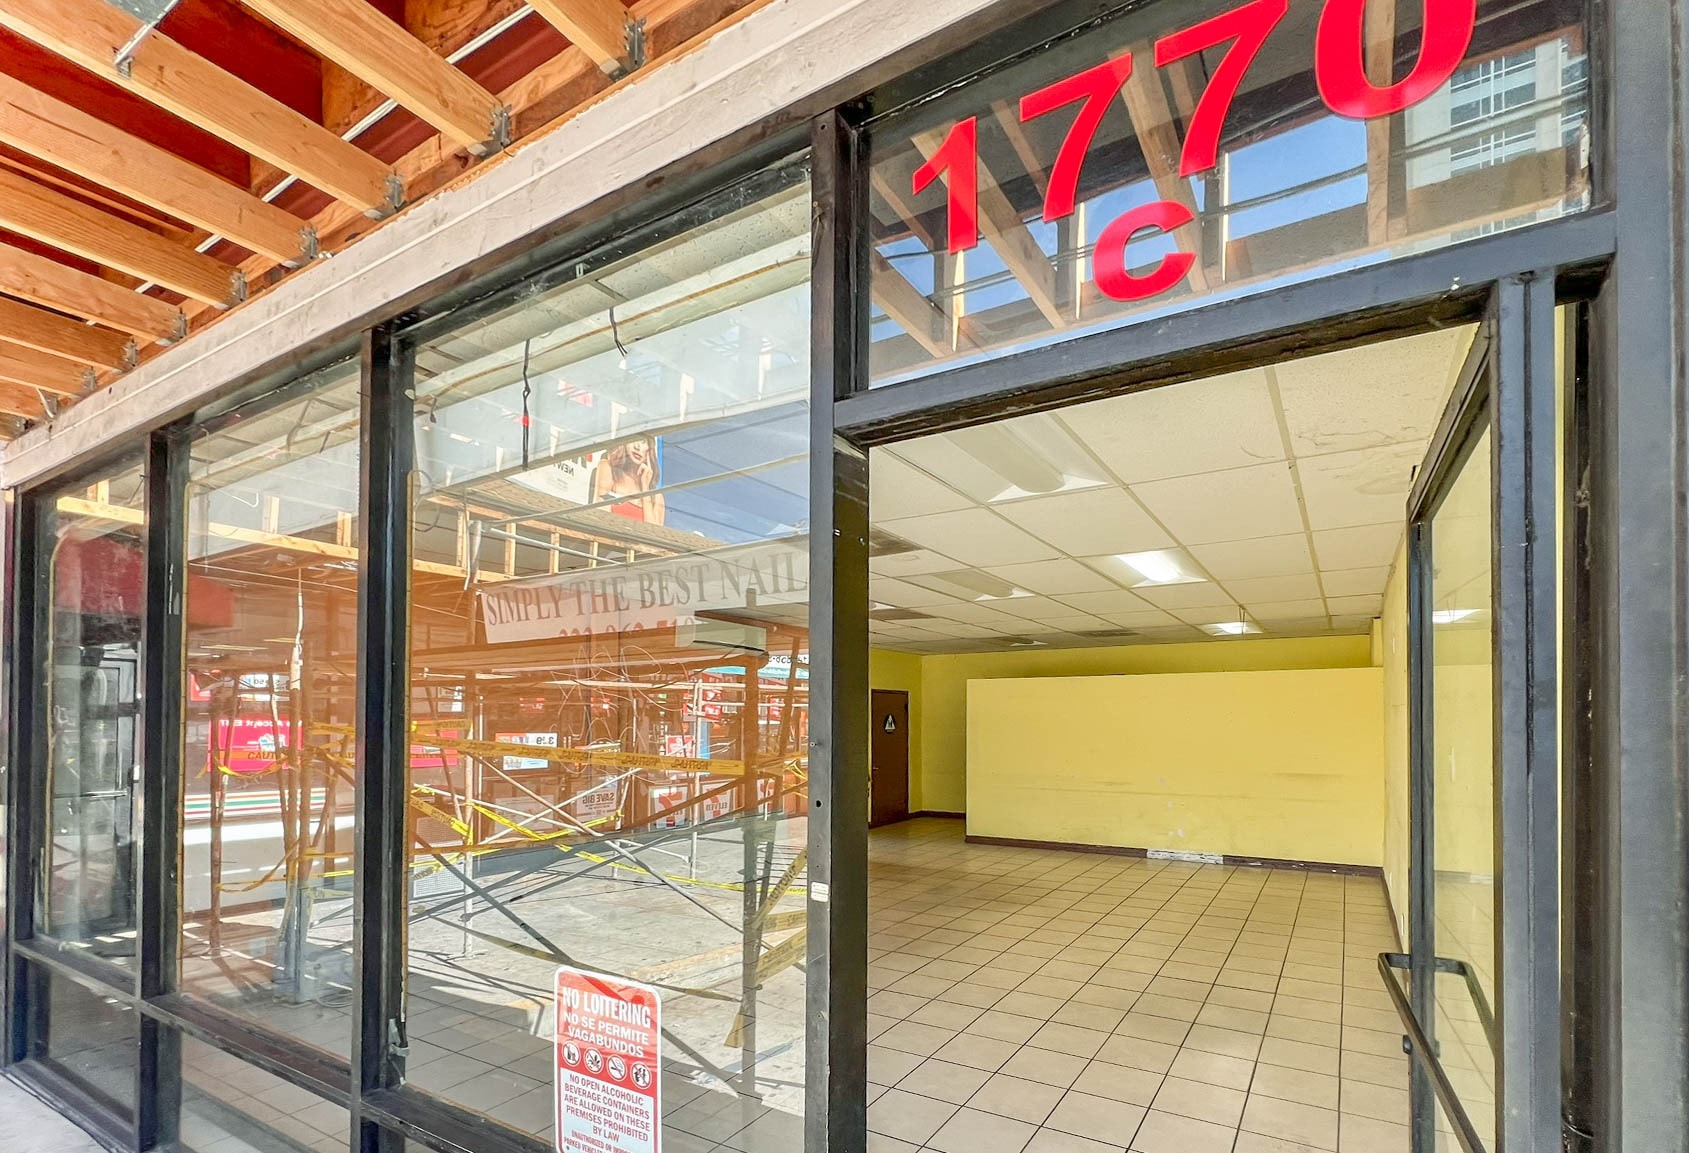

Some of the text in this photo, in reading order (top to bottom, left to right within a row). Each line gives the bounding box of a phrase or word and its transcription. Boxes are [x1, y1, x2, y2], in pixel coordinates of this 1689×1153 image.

[912, 0, 1476, 254] 1770
[487, 584, 562, 626] SIMPLY
[570, 576, 630, 616] THE
[639, 564, 709, 609] BEST
[621, 755, 661, 767] CAUTION
[670, 758, 711, 770] CAUTION
[562, 986, 651, 1029] NO LOITERING
[563, 1011, 649, 1045] NO SE PERMITE
[568, 1025, 644, 1057] VAGABUNDOS
[564, 1083, 650, 1120] BEVERAGE CONTAINERS
[569, 1073, 644, 1106] NO OPEN ALCOHOLIC
[564, 1093, 651, 1132] ARE ALLOWED ON THESE
[566, 1104, 649, 1142] PREMISES PROHIBITED
[564, 1136, 582, 1149] PARKED
[571, 1130, 604, 1149] UNAUTHORIZED
[592, 1126, 620, 1143] BY LAW
